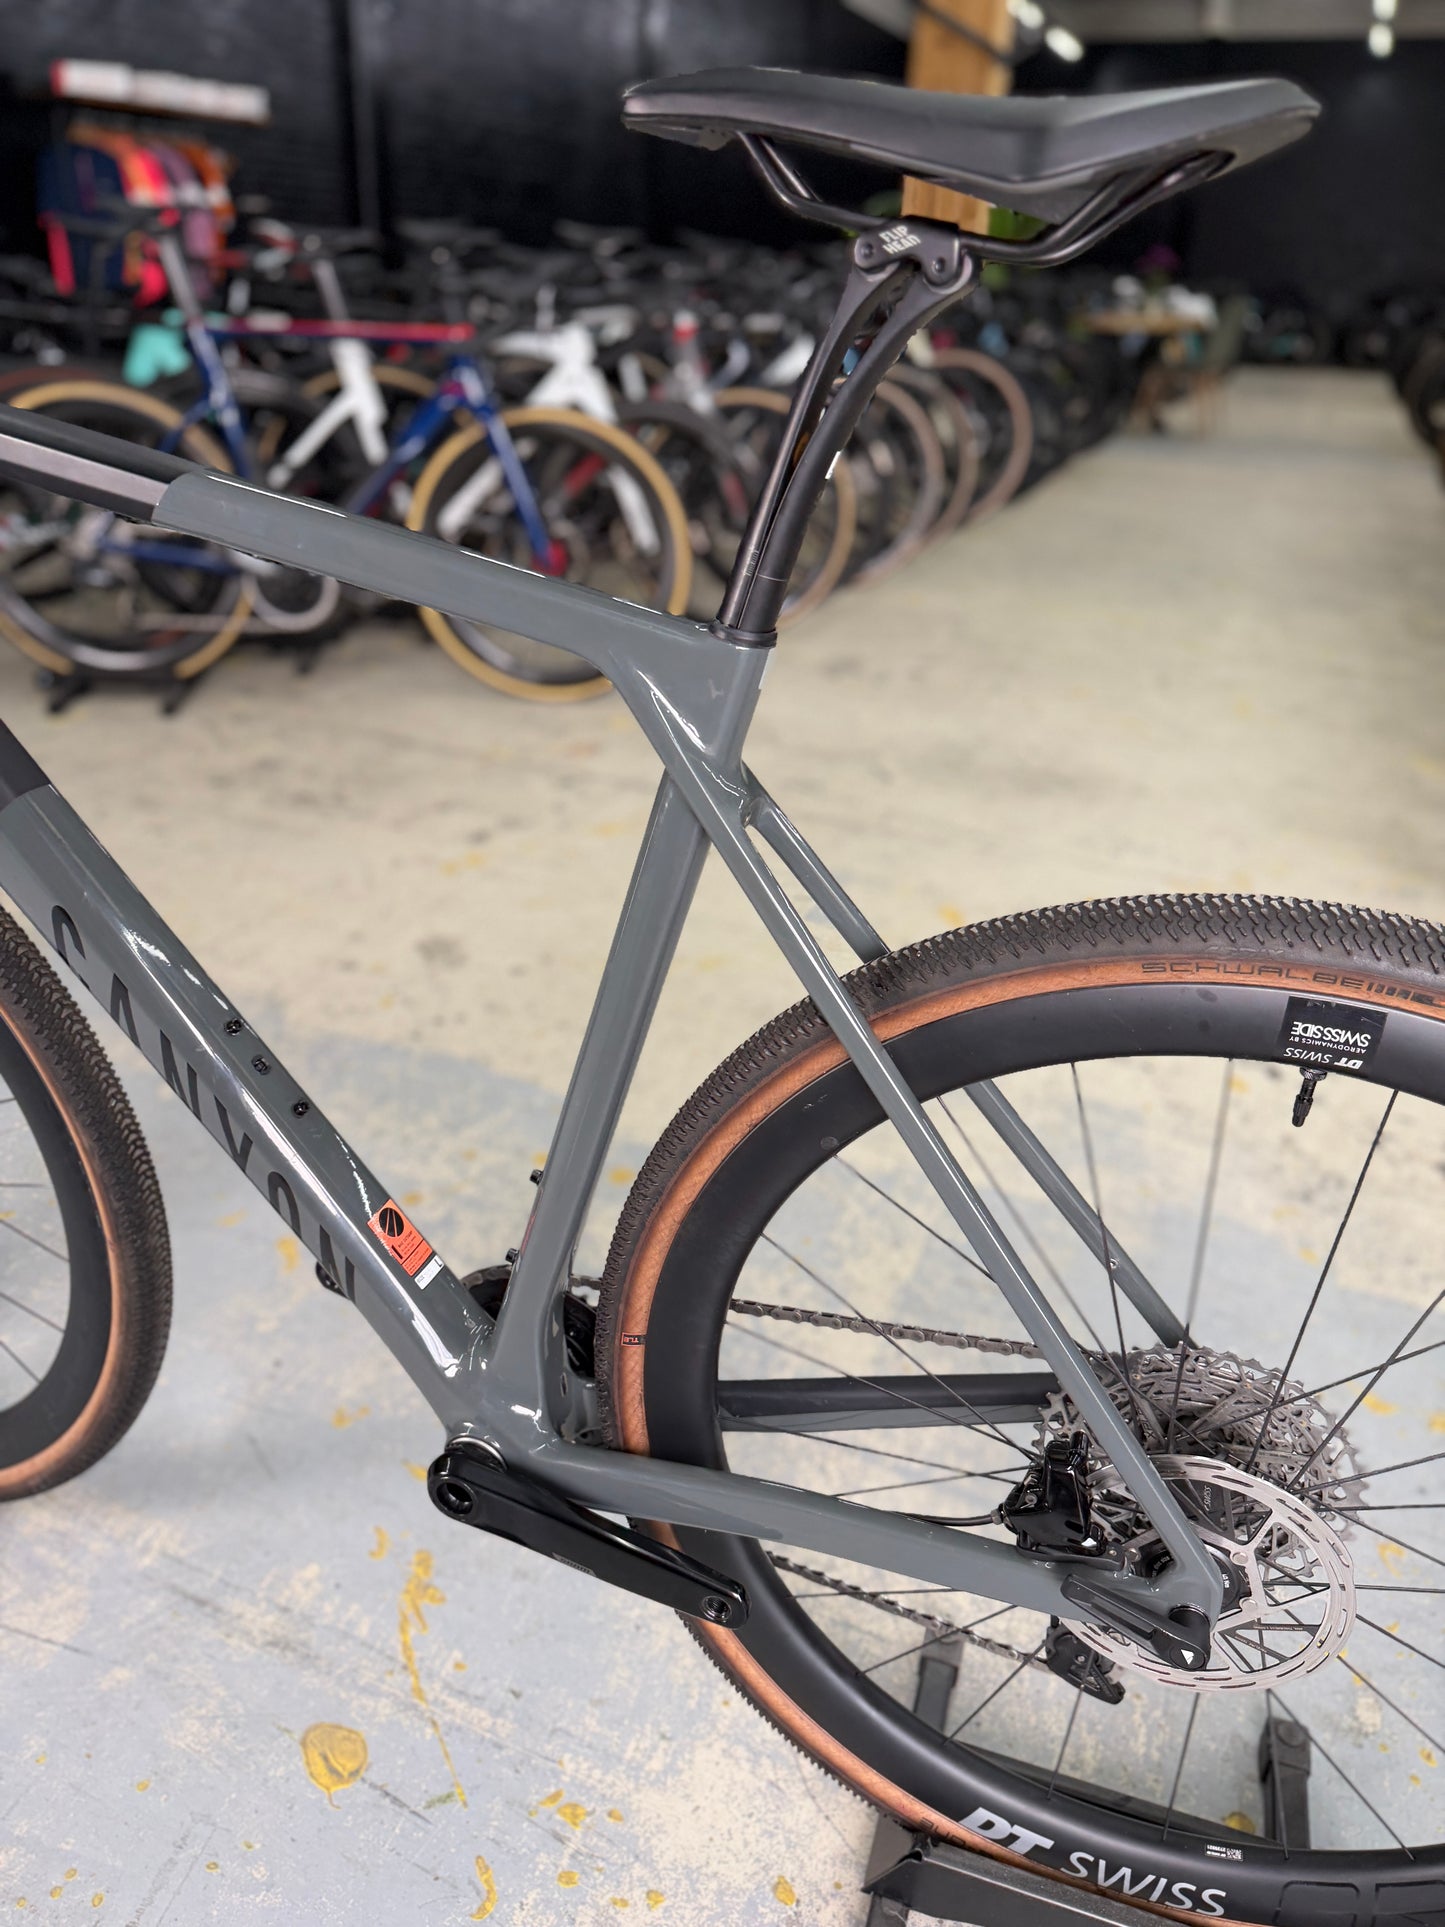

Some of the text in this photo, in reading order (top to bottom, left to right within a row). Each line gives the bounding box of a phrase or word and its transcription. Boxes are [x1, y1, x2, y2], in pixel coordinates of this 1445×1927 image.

[879, 225, 908, 243] FLIP
[1141, 962, 1364, 990] SCHWALBE
[1302, 1038, 1367, 1055] AERODYNAMICS
[1283, 1047, 1364, 1070] DT SWISS
[958, 1806, 1227, 1917] DT SWISS
